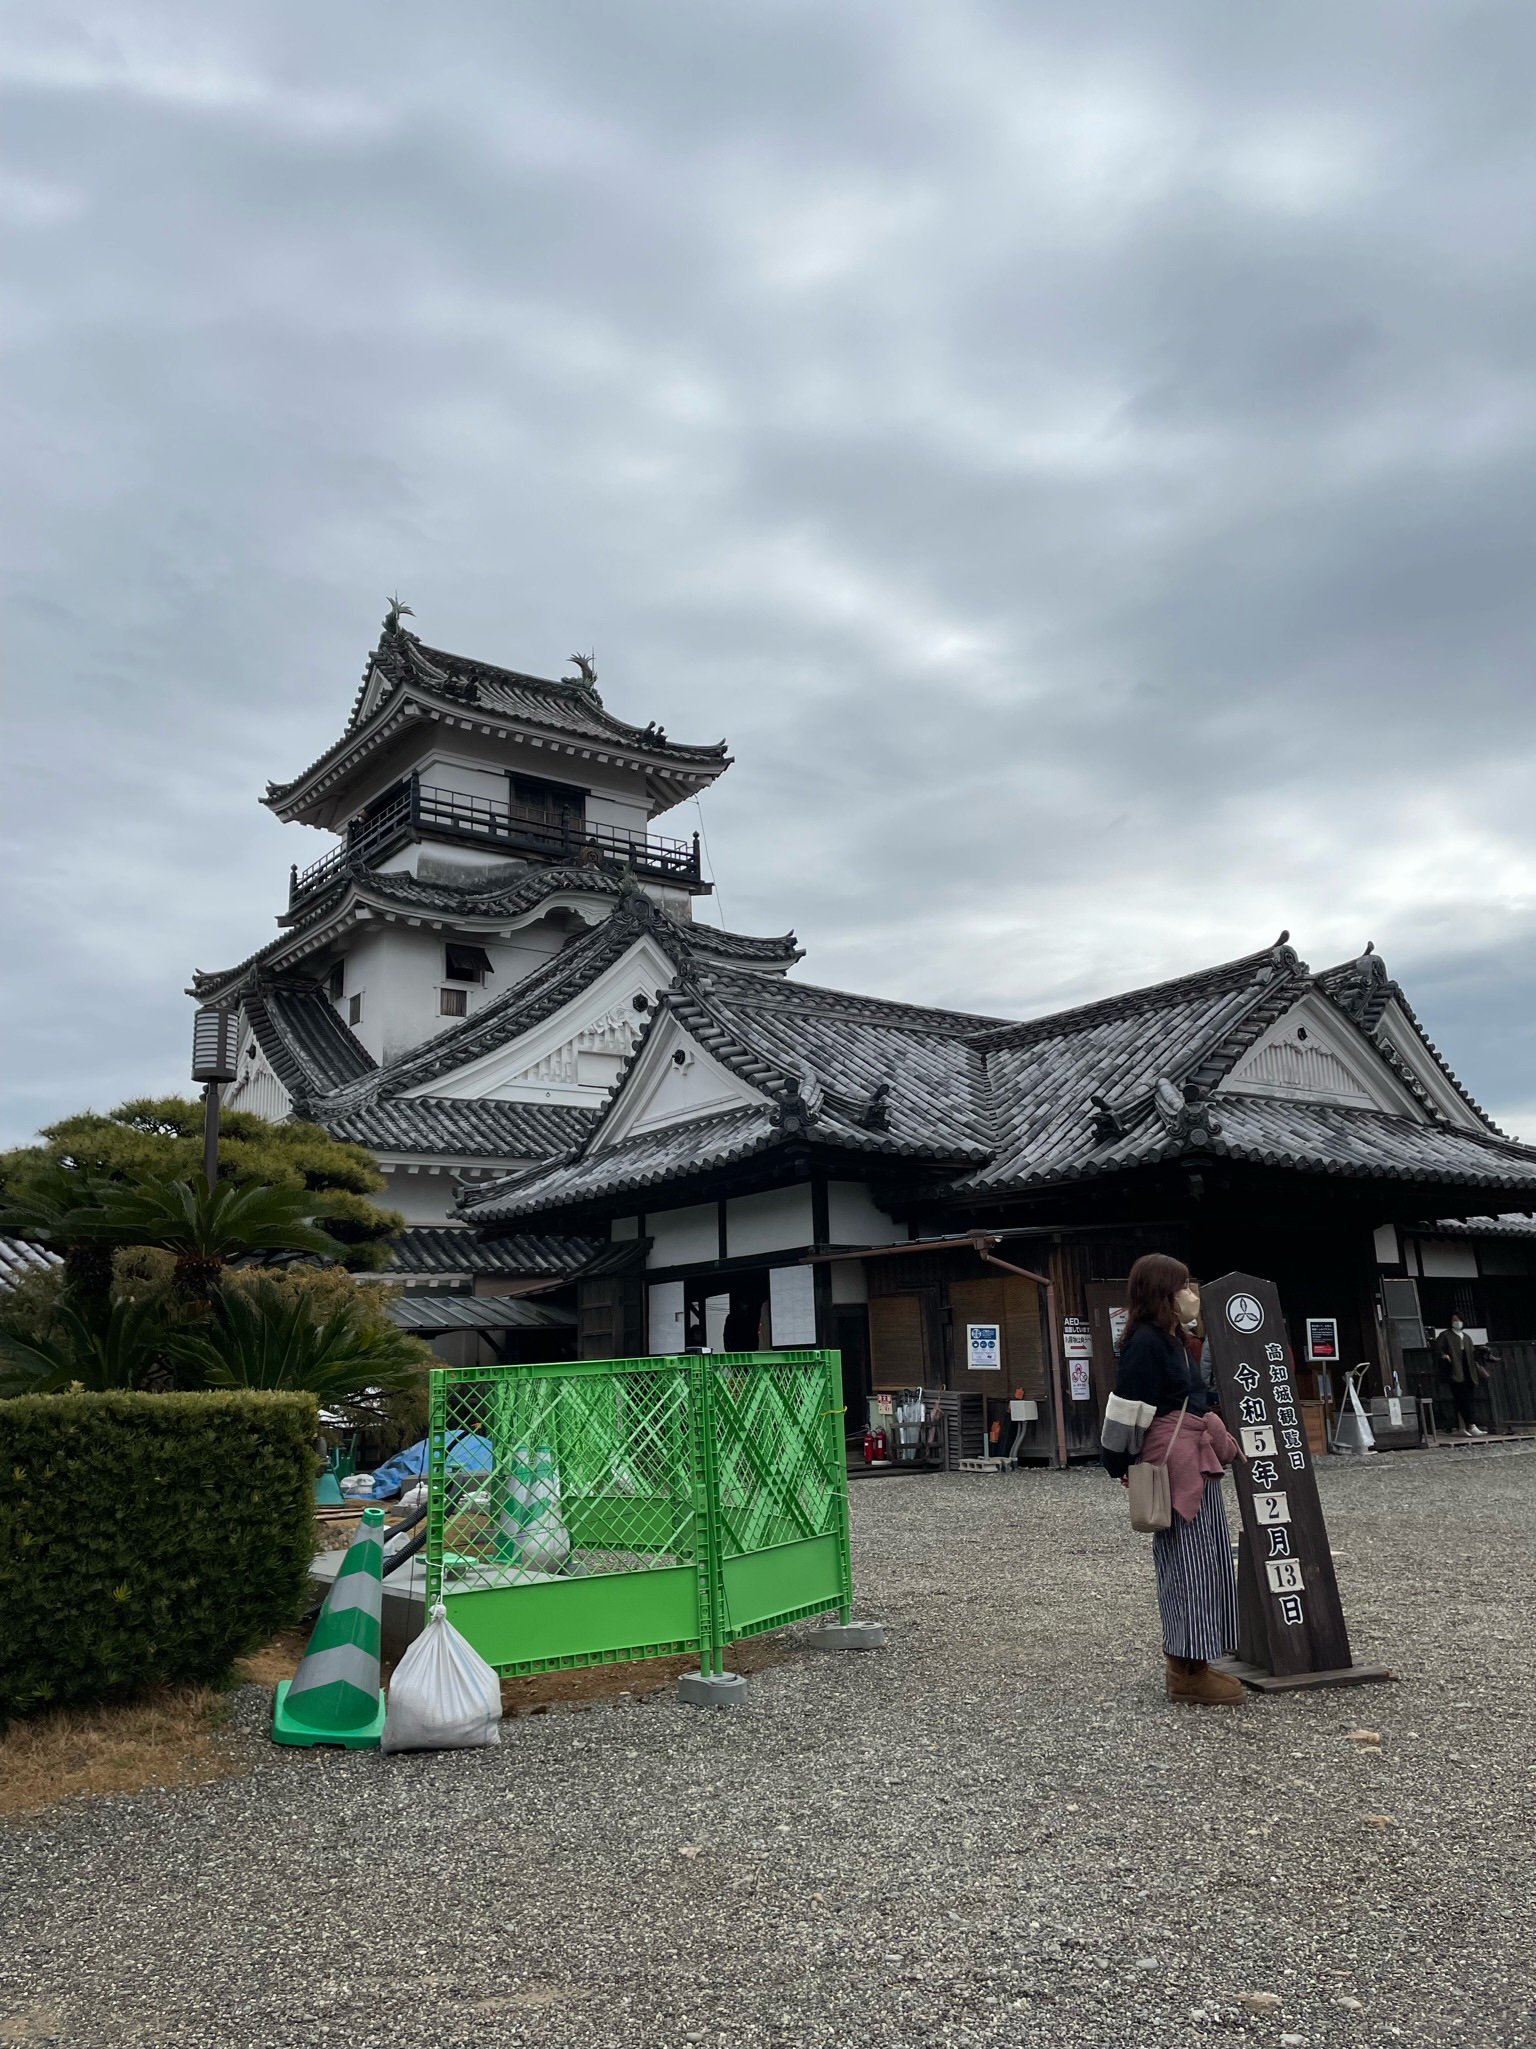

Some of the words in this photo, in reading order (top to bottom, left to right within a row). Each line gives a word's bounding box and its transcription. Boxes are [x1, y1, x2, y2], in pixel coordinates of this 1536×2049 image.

[1064, 1317, 1079, 1326] AED
[1264, 1343, 1305, 1470] 高知城観覧日
[1233, 1363, 1304, 1626] 令和5年2月13日
